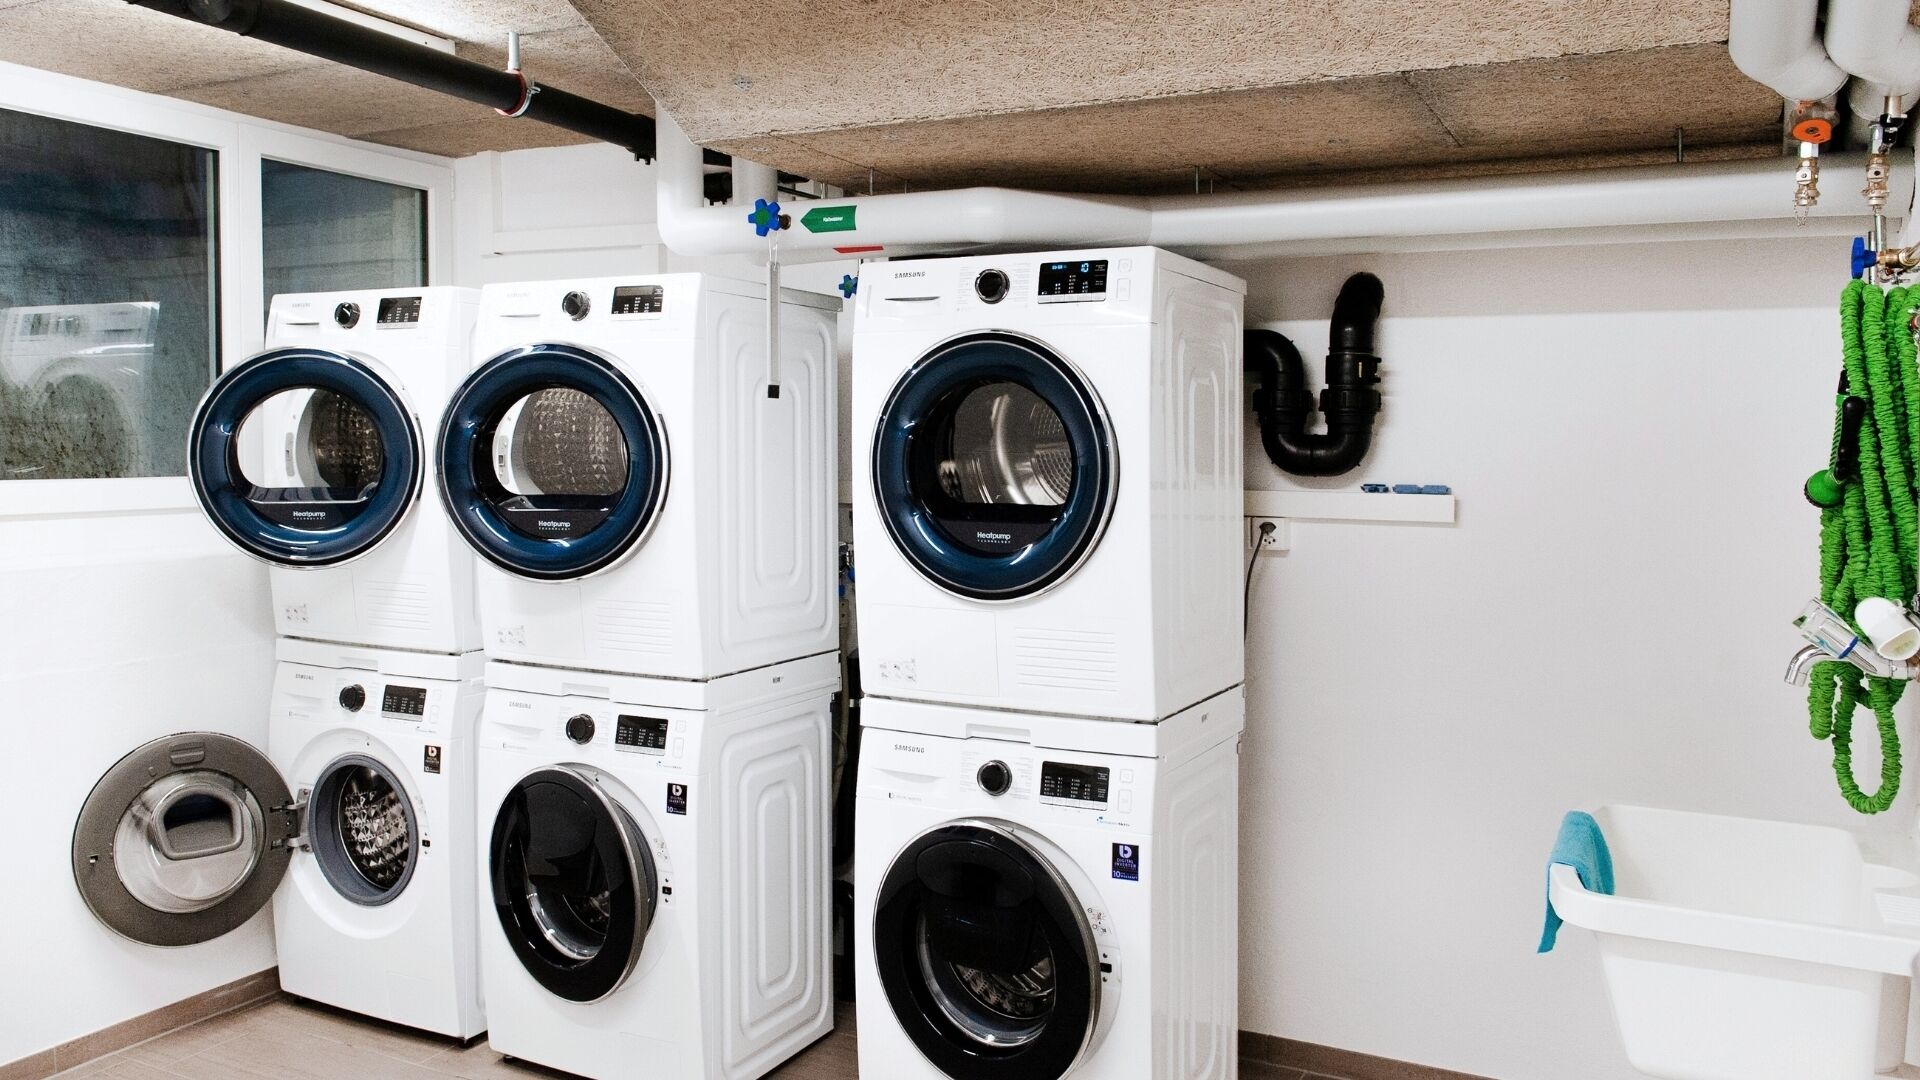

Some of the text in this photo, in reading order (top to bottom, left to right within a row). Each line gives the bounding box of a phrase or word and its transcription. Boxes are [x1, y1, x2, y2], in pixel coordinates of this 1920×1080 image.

[894, 271, 926, 279] SAMSUNG
[292, 510, 326, 518] Heatpump
[538, 520, 571, 528] Heatpump
[977, 532, 1011, 540] Heatpump
[894, 744, 925, 754] SAMSUNG
[1112, 870, 1121, 878] 10
